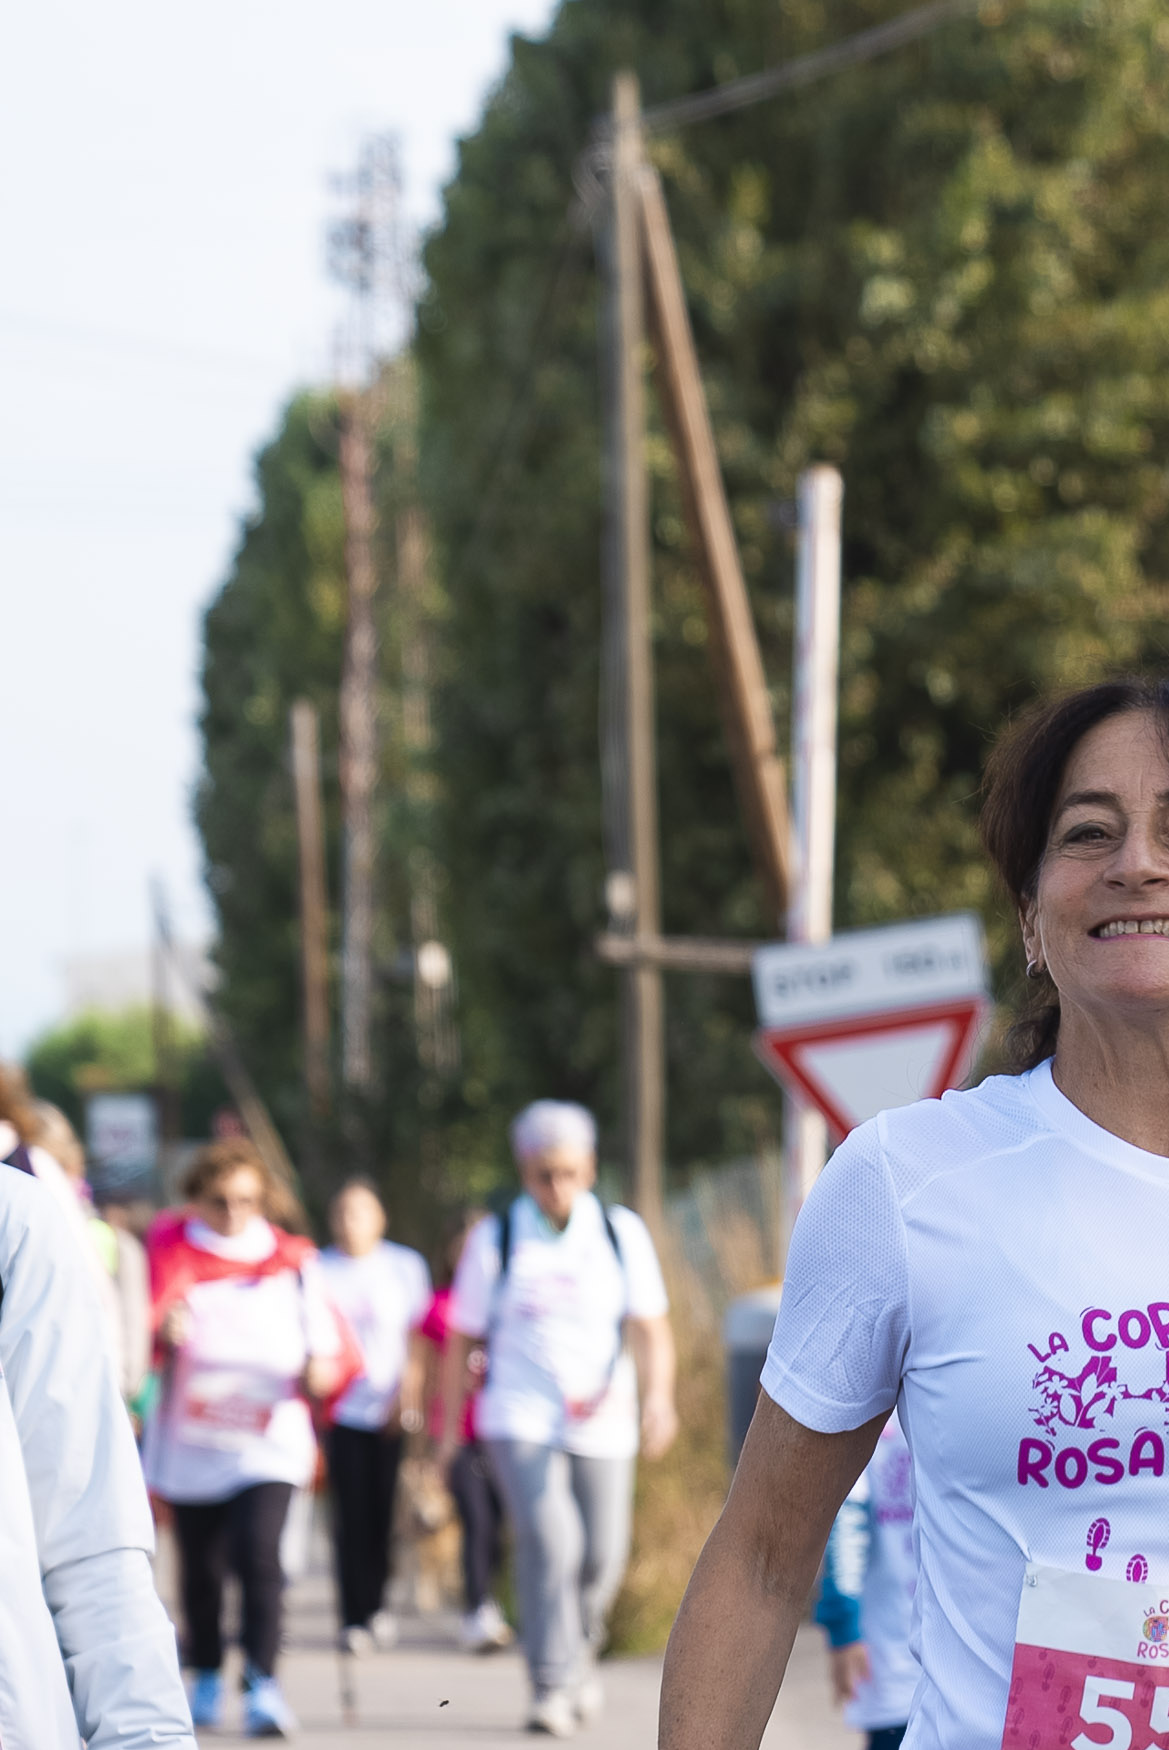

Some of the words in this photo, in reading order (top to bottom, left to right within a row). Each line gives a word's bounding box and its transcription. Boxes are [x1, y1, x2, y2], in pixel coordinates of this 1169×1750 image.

[1028, 1332, 1069, 1362] LA
[1018, 1430, 1164, 1489] ROSA
[1144, 1606, 1155, 1617] LA
